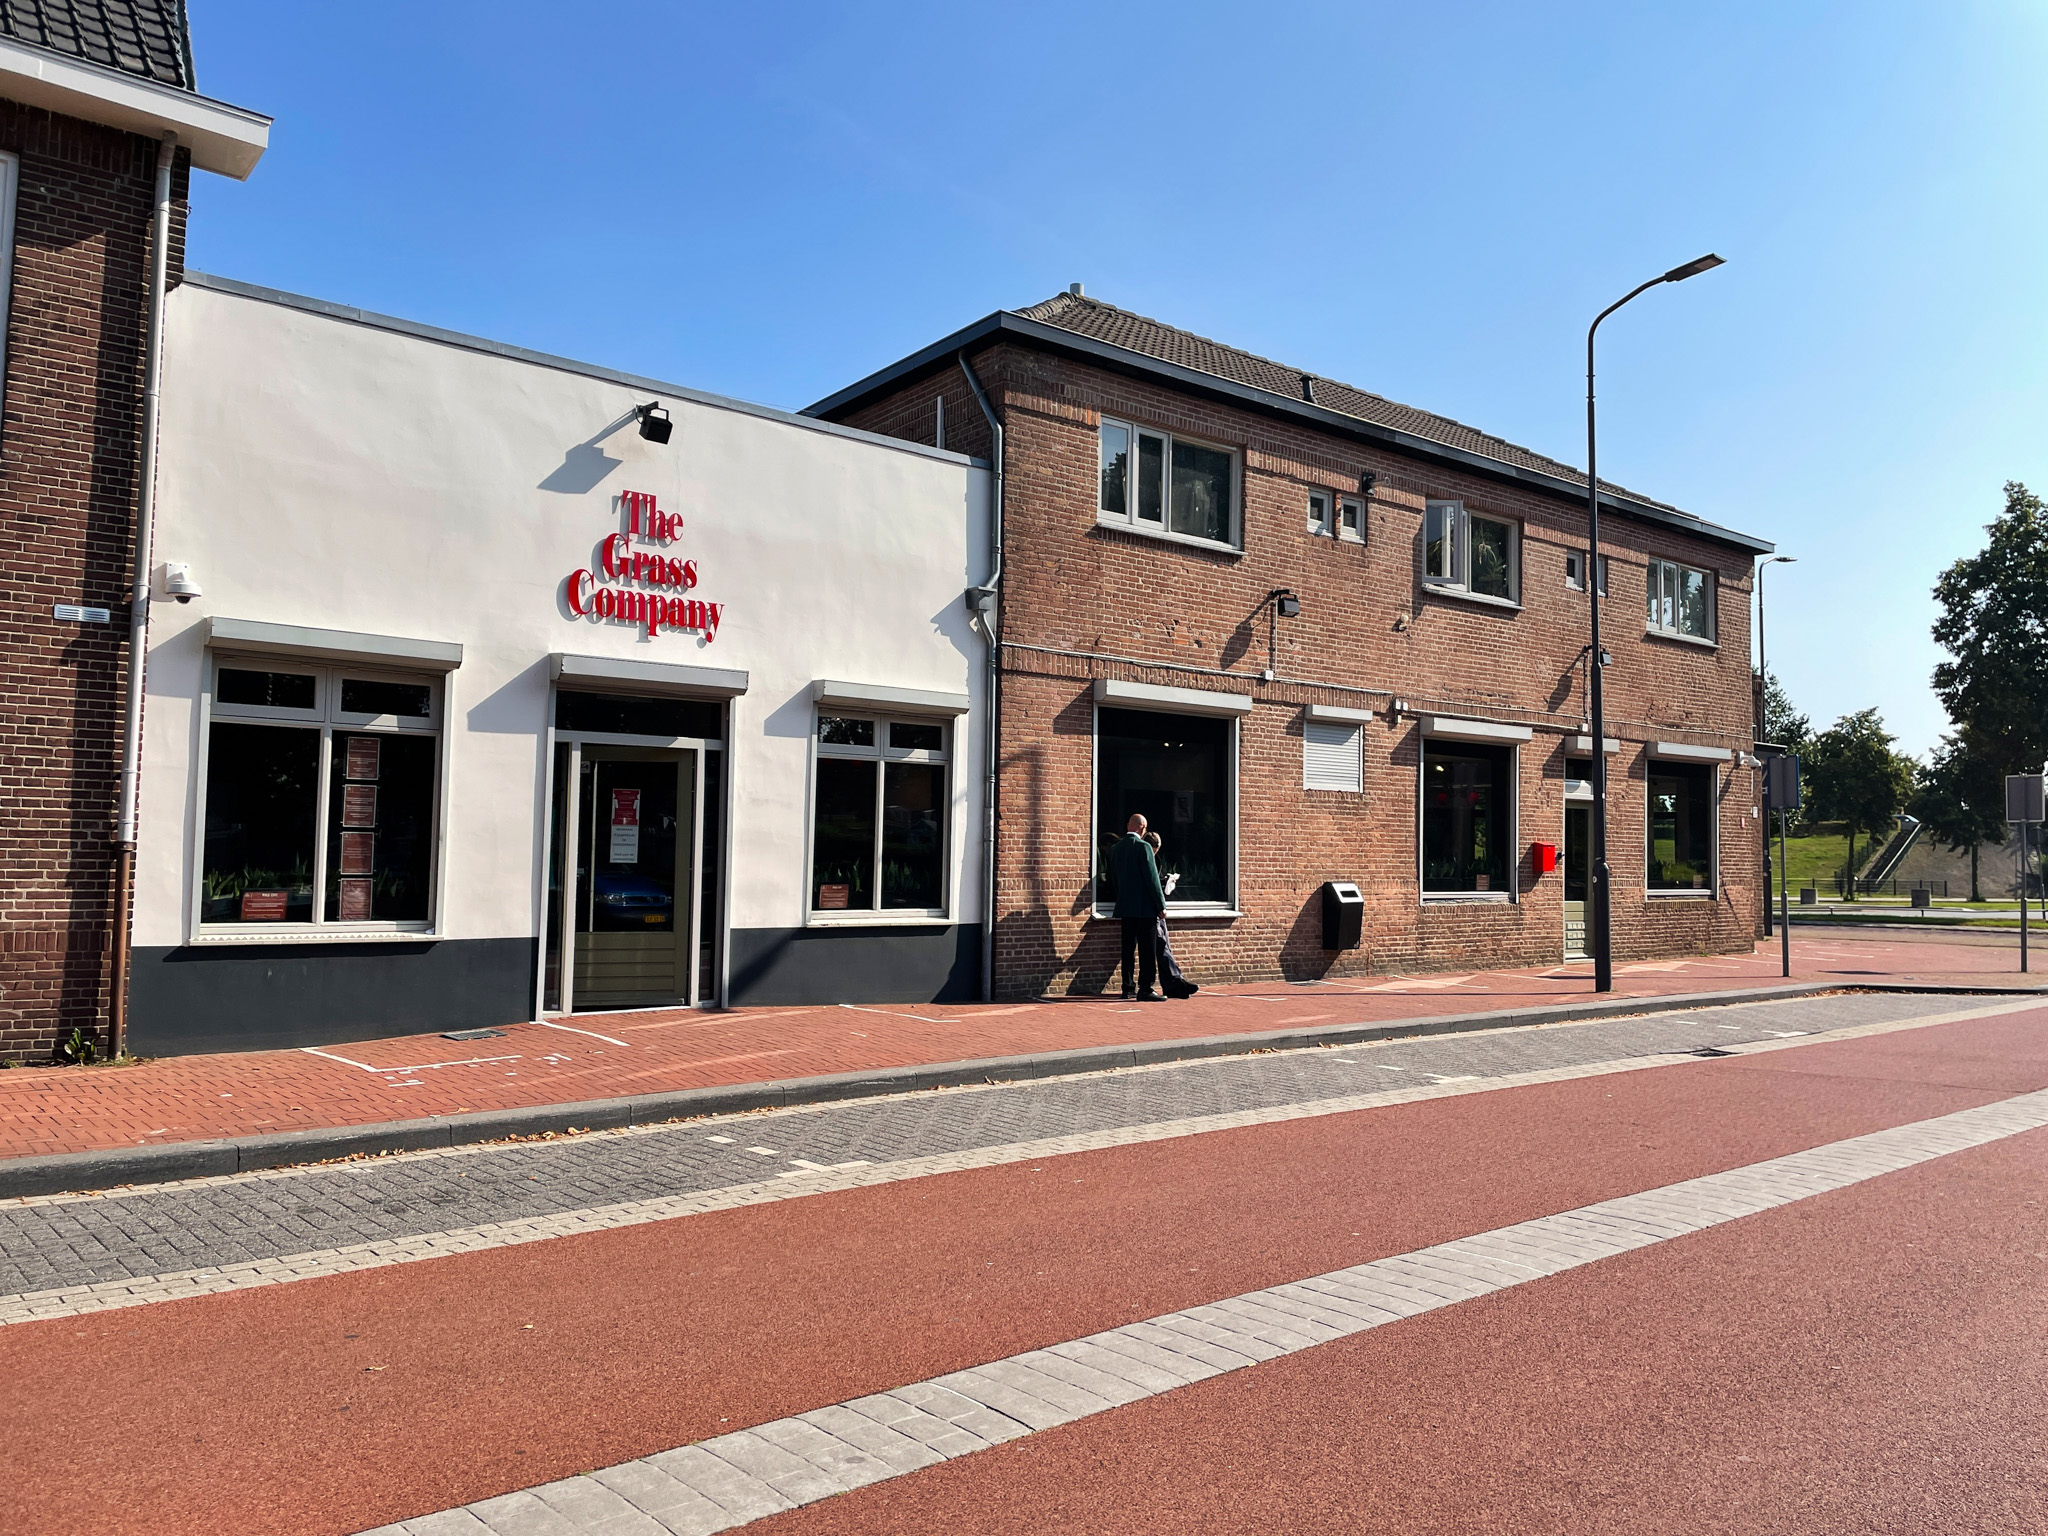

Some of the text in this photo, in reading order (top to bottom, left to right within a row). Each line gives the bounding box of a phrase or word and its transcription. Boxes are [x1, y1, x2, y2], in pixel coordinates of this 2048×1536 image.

[622, 490, 684, 541] The
[602, 532, 698, 589] Grass
[567, 568, 725, 643] Company
